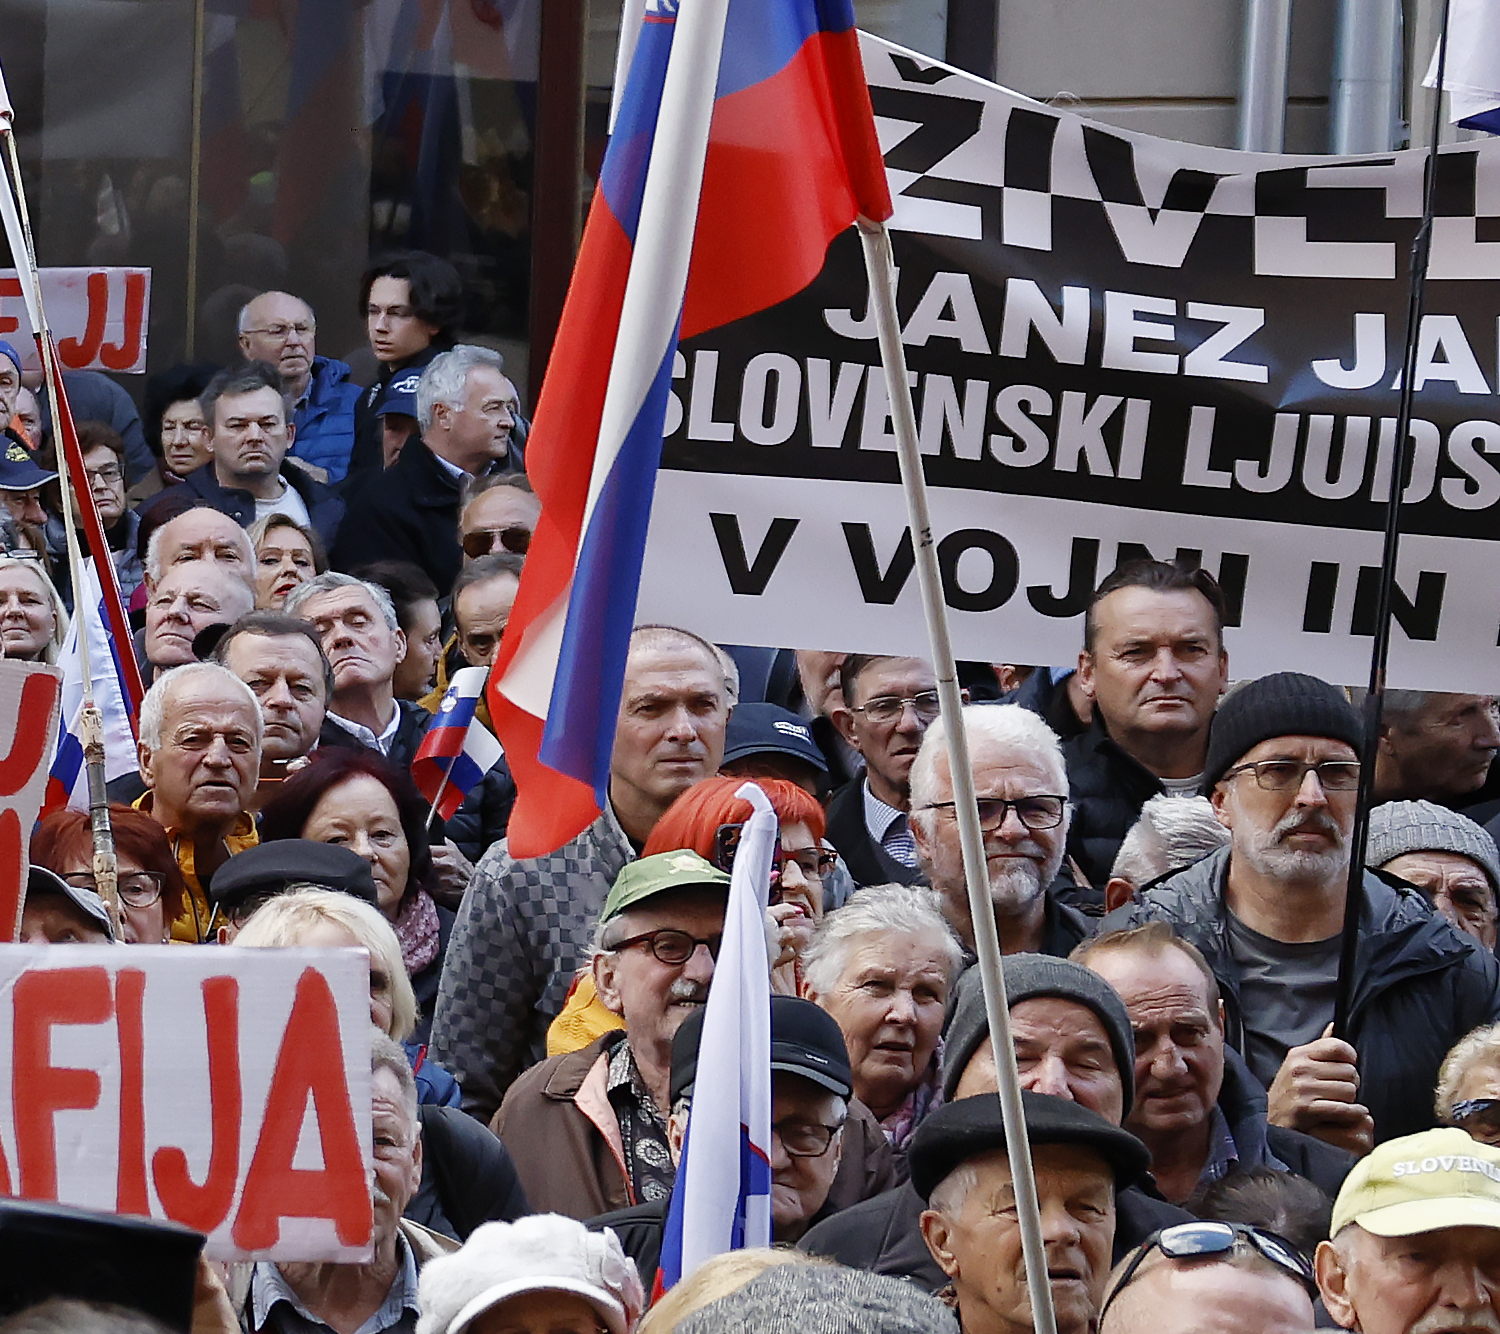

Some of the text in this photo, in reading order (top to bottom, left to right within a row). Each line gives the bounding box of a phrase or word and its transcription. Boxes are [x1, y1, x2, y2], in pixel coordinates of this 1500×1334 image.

[58, 272, 148, 371] JJ
[822, 266, 1500, 397] JANEZ JA
[660, 348, 1152, 481] SLOVENSKI
[708, 511, 801, 597] V
[1302, 560, 1448, 642] IN
[1393, 1154, 1500, 1184] SLOVENI
